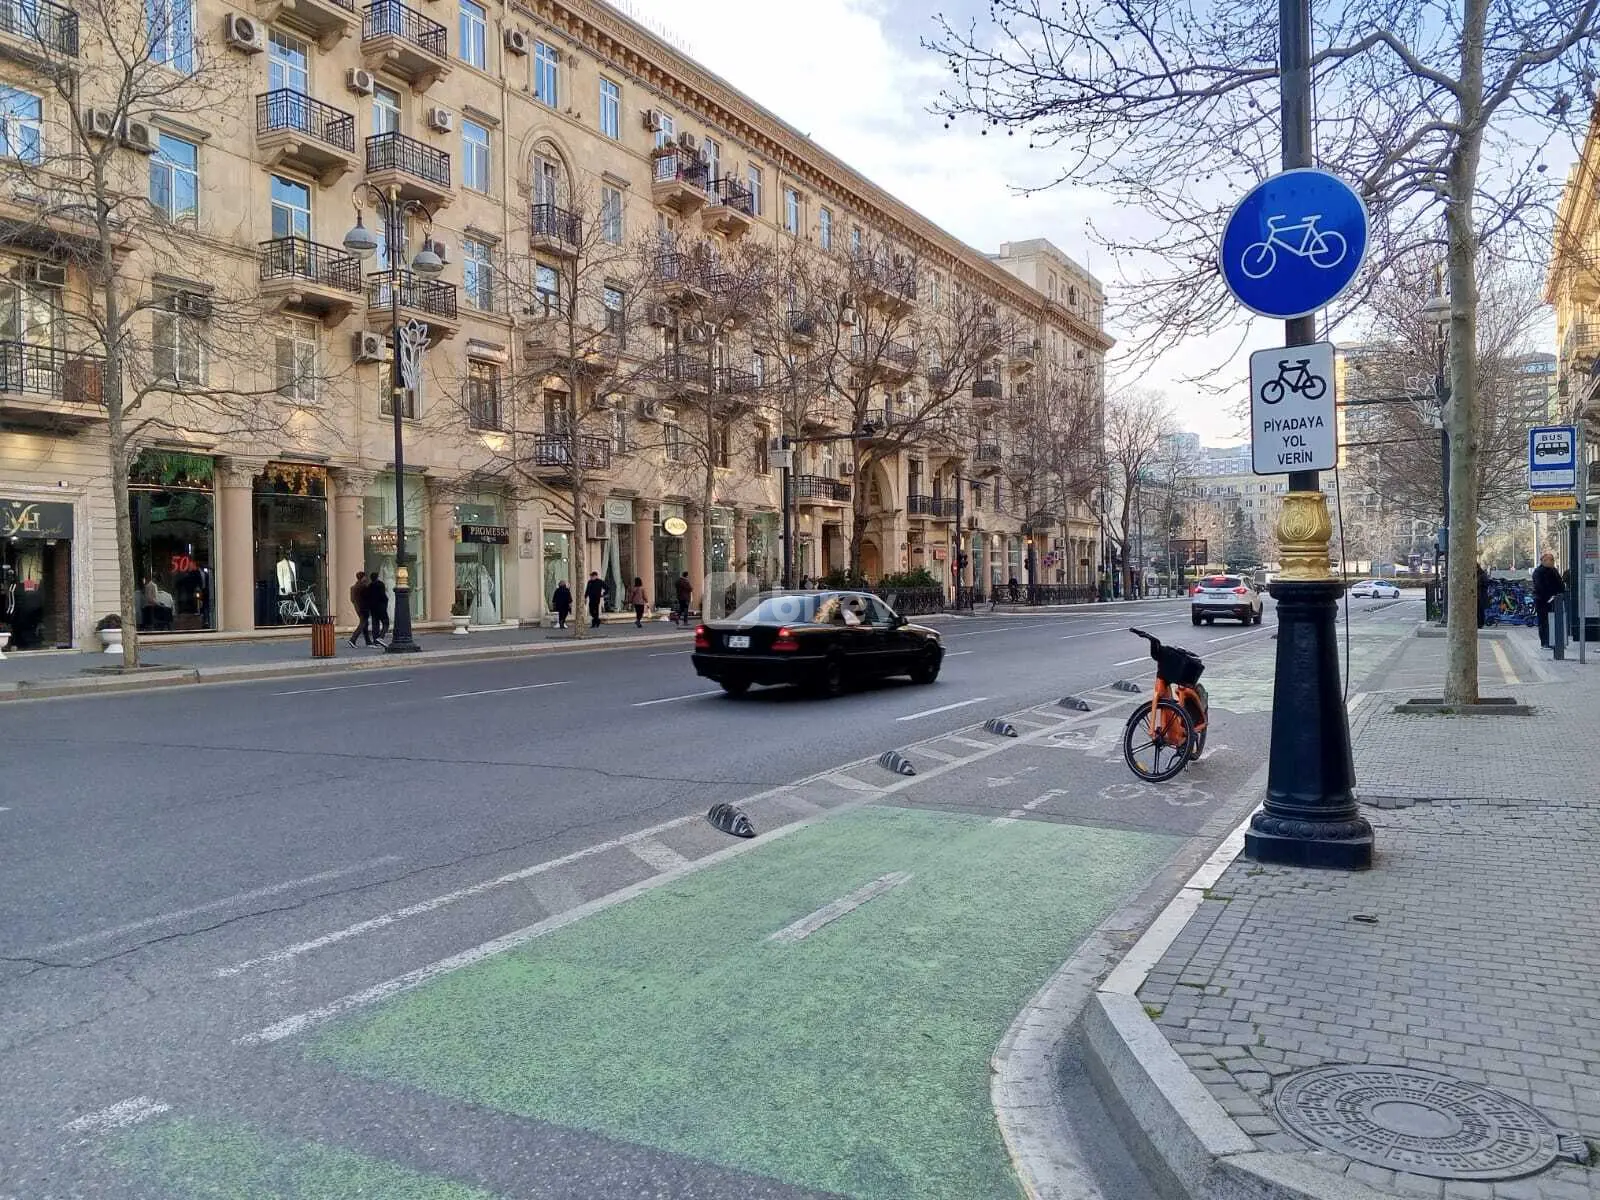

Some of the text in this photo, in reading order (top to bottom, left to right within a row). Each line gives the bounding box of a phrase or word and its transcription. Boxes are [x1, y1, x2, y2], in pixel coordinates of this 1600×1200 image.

[1264, 415, 1324, 432] PİYADAYA
[1283, 435, 1307, 448] YOL
[1542, 433, 1563, 441] BUS
[1277, 450, 1313, 465] VERİN
[470, 526, 510, 536] PROMESSA
